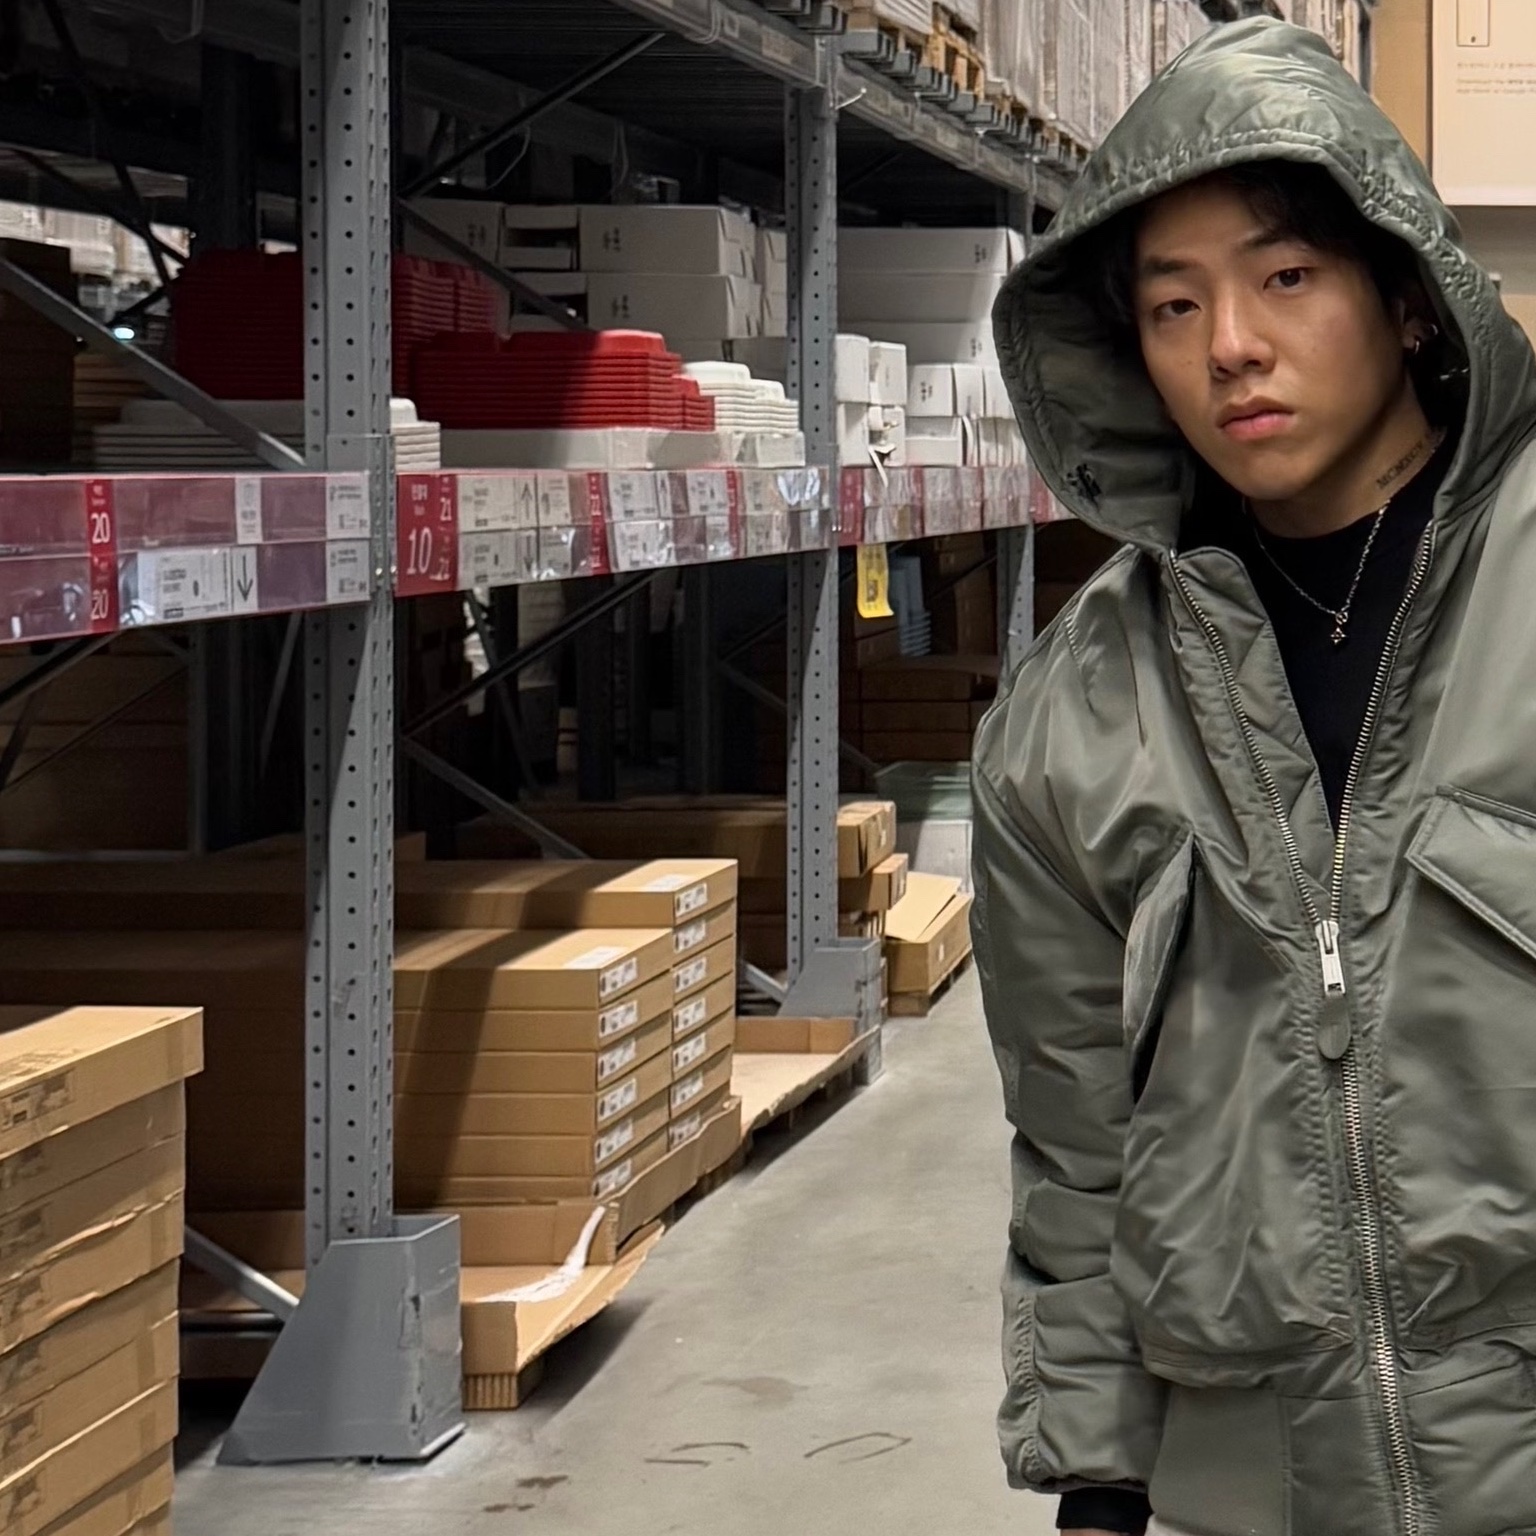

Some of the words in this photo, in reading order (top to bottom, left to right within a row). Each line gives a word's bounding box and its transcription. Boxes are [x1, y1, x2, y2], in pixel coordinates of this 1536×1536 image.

[440, 497, 453, 521] 21
[90, 512, 111, 544] 20
[406, 527, 433, 575] 10
[90, 589, 109, 621] 20
